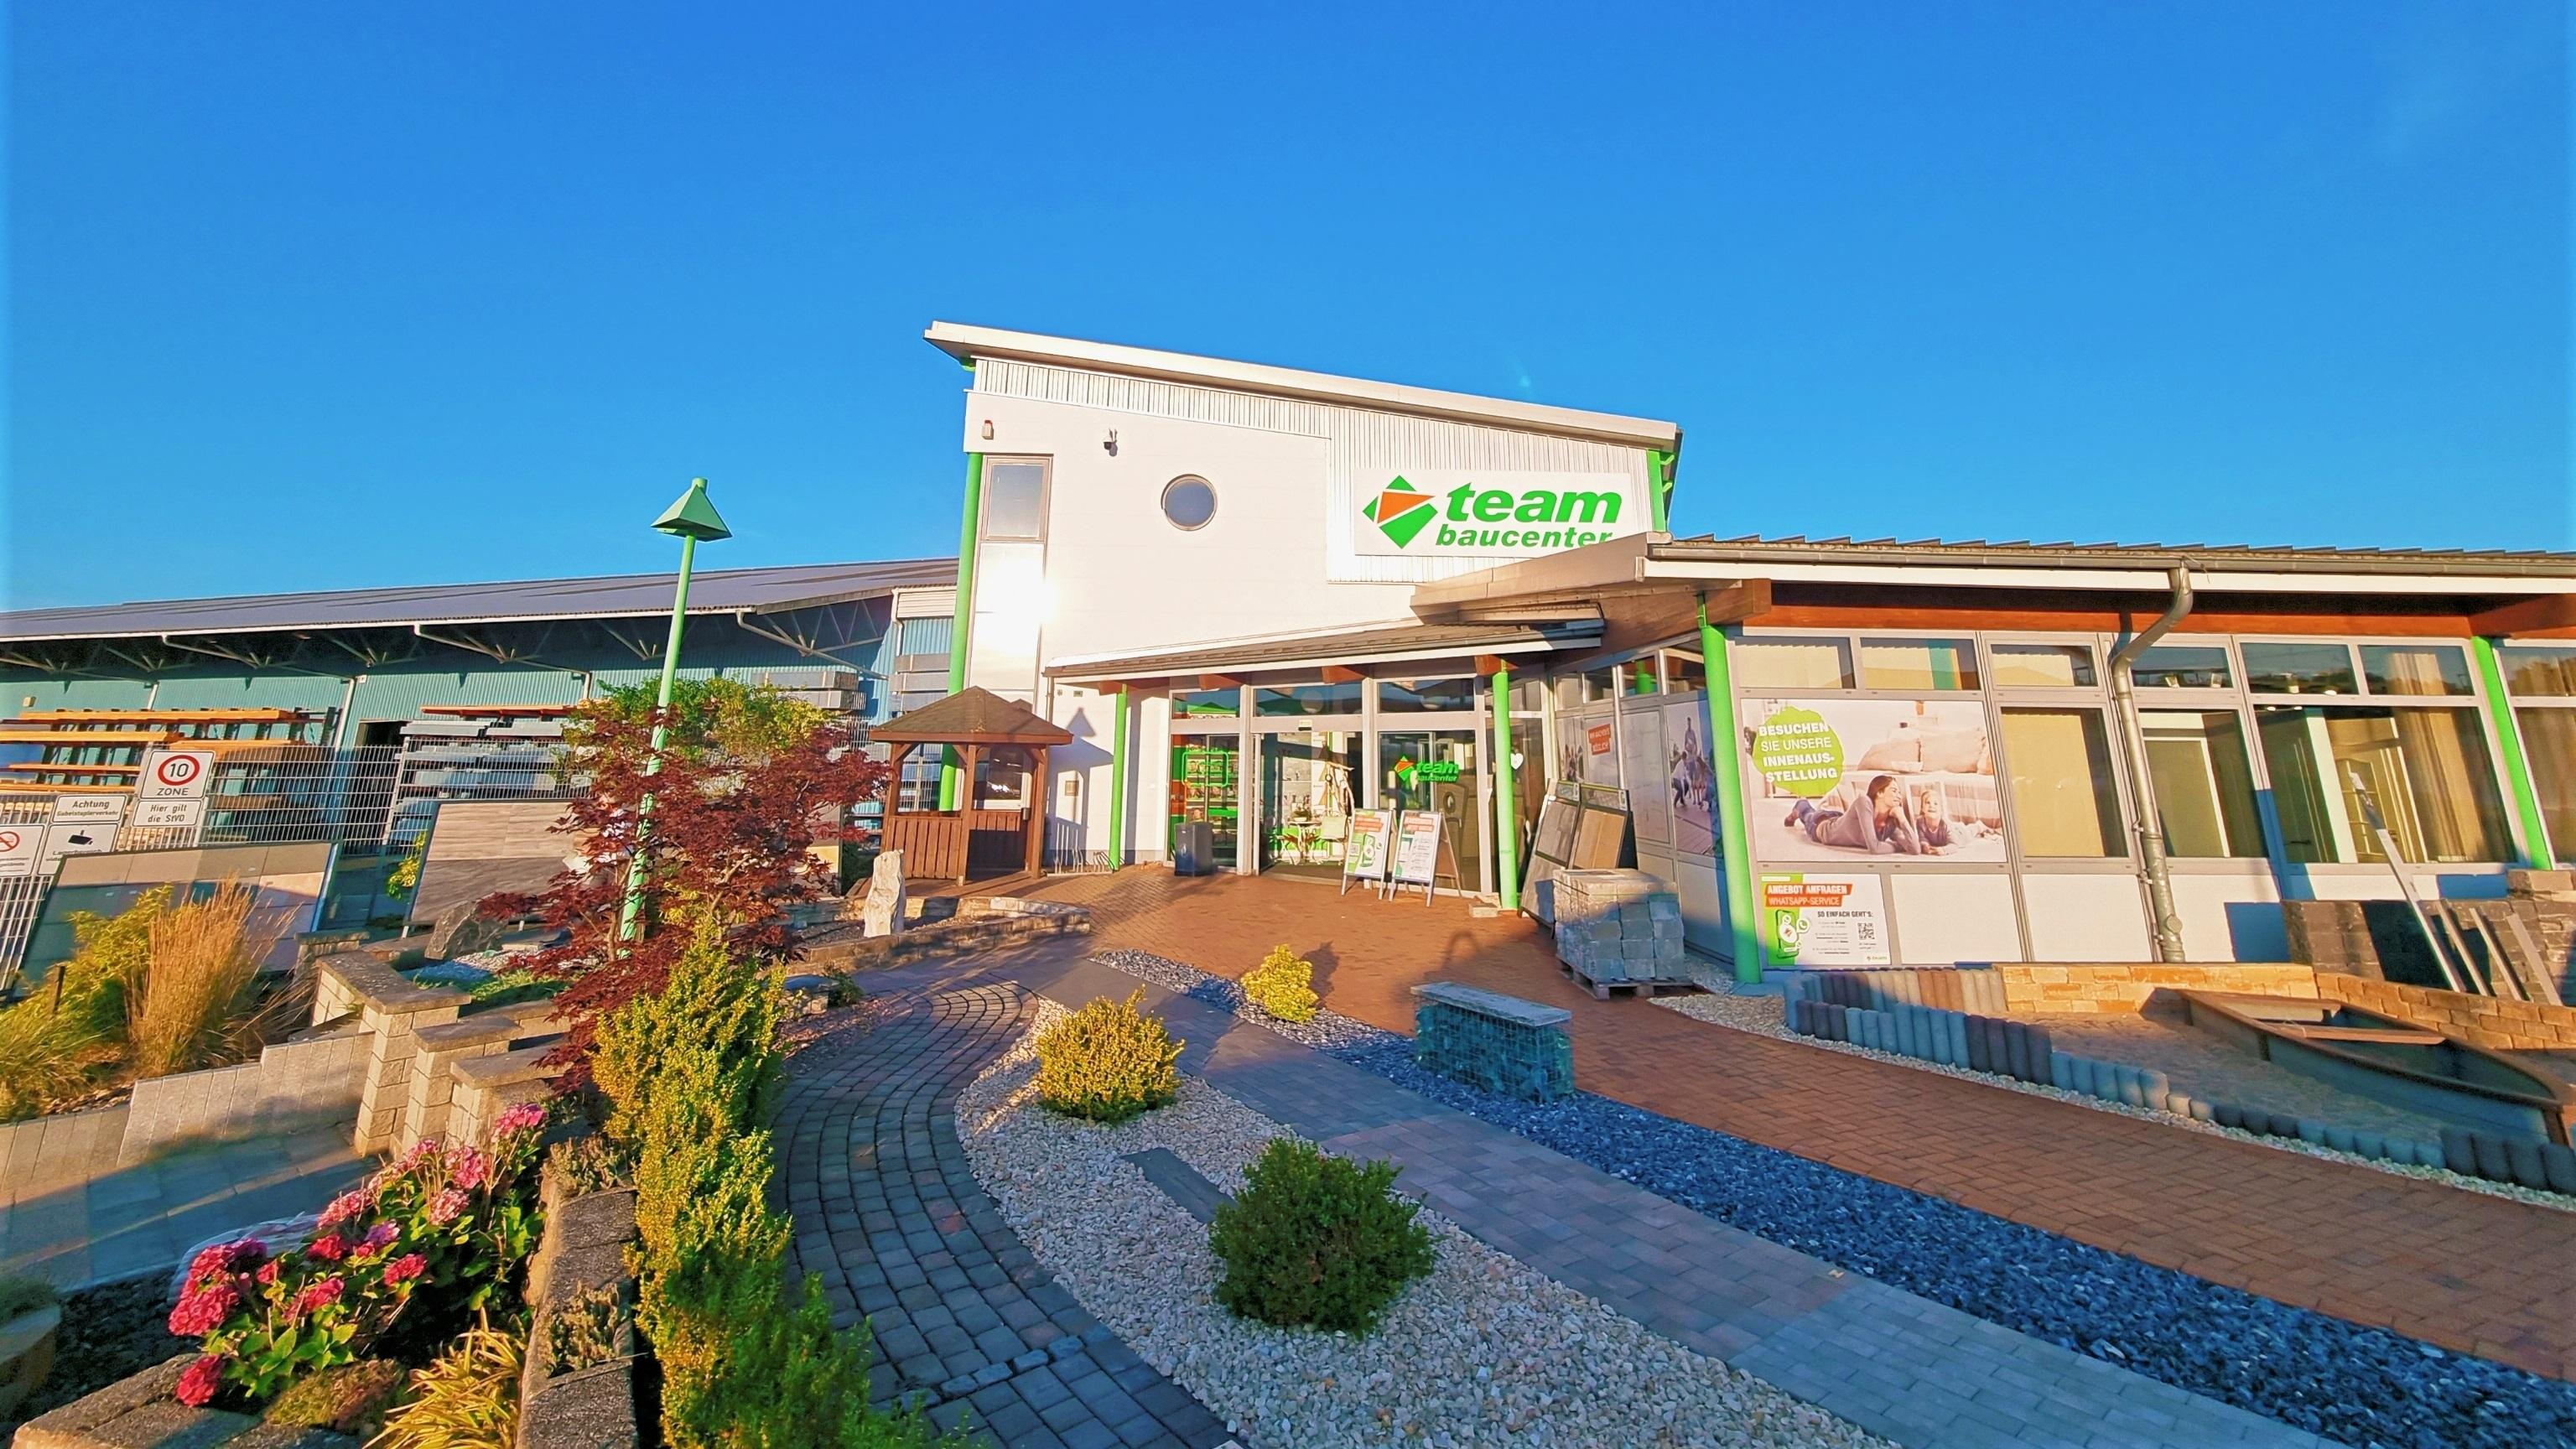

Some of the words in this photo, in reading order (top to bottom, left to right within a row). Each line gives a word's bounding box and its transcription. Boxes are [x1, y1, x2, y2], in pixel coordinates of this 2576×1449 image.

[1446, 482, 1623, 524] team
[1436, 524, 1613, 548] baucenter
[1758, 722, 1829, 737] BESUCHEN
[1761, 740, 1780, 752] SIE
[1783, 736, 1832, 750] UNSERE
[1763, 752, 1836, 767] INNENAUS-
[170, 763, 189, 777] 10
[1416, 761, 1459, 774] team
[1766, 767, 1838, 783] STELLUNG
[72, 800, 110, 810] Achtung
[150, 804, 168, 813] Hier
[172, 804, 187, 813] gilt
[165, 814, 184, 823] StVO
[1767, 885, 1803, 895] ANGEBOT
[1805, 885, 1847, 895] ANFRAGEN
[1768, 896, 1840, 906] WHATSAPP-SERVICE
